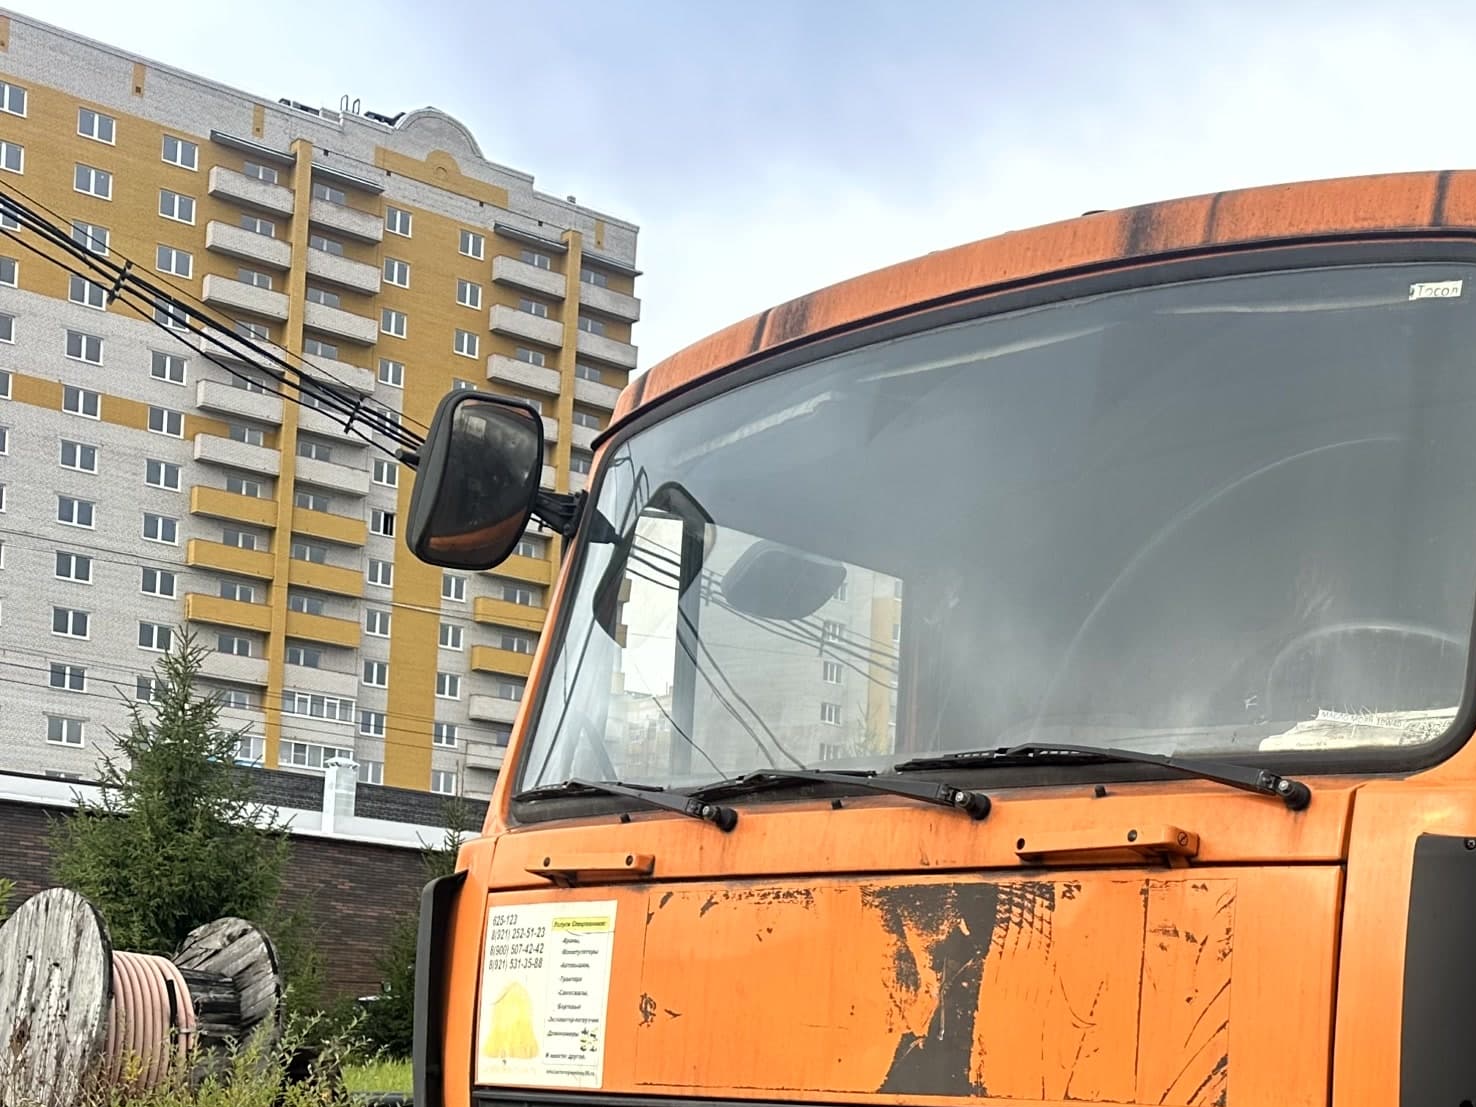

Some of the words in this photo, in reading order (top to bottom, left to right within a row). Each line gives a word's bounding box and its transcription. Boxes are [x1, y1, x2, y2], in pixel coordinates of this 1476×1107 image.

[492, 914, 518, 926] 625-123
[511, 927, 546, 940] 252-51-23
[510, 942, 544, 956] 507-42-42
[508, 957, 543, 970] 531-35-88
